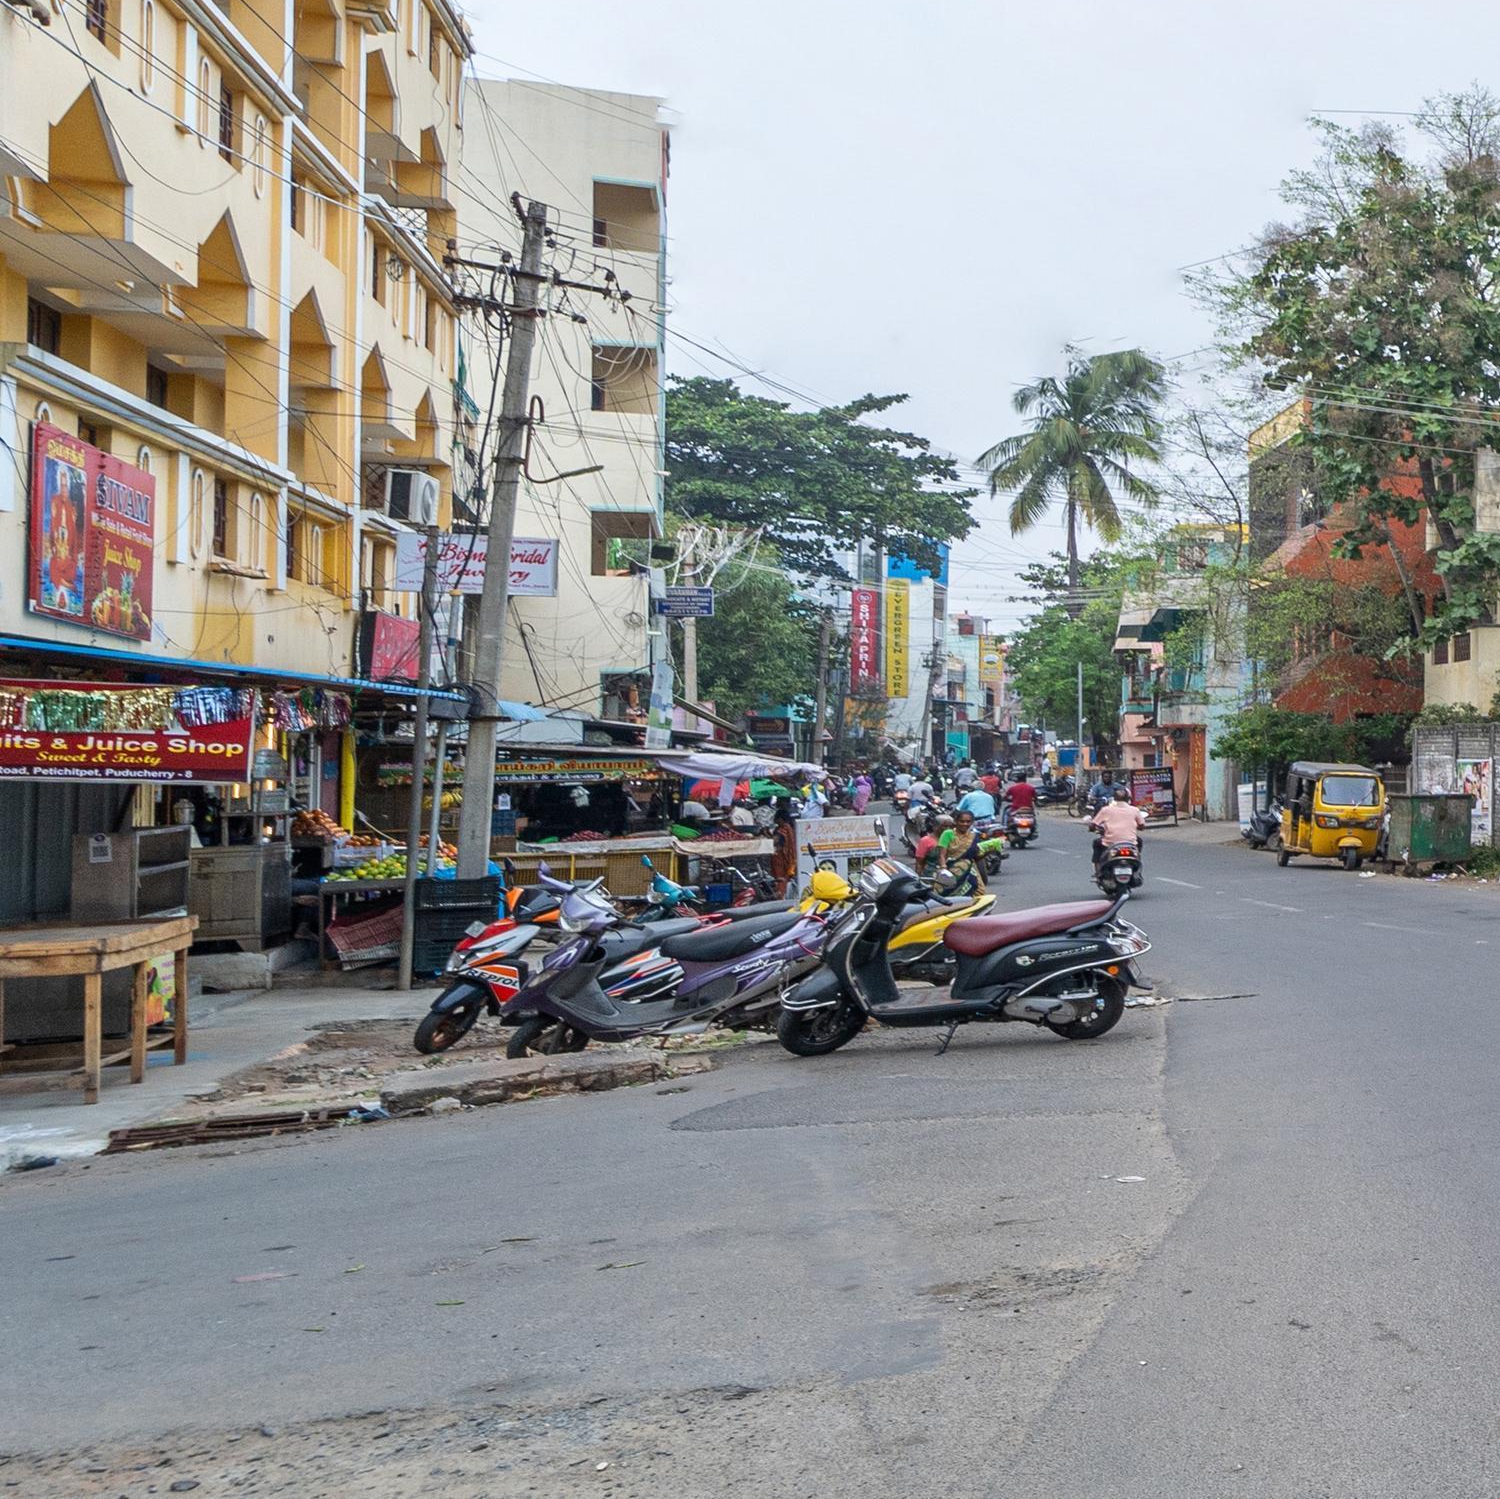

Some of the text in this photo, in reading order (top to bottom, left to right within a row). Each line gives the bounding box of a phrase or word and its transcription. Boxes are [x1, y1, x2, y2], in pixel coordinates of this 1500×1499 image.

[96, 473, 151, 526] SIVAM
[103, 539, 122, 566] Juice
[858, 603, 870, 644] SHIVA
[50, 737, 68, 751] &
[77, 736, 159, 752] Juice
[167, 738, 245, 758] Shop
[36, 751, 162, 766] Sweet & Tasty
[105, 768, 175, 780] Puducherry
[185, 770, 193, 778] 8
[466, 969, 520, 987] REPSOL
